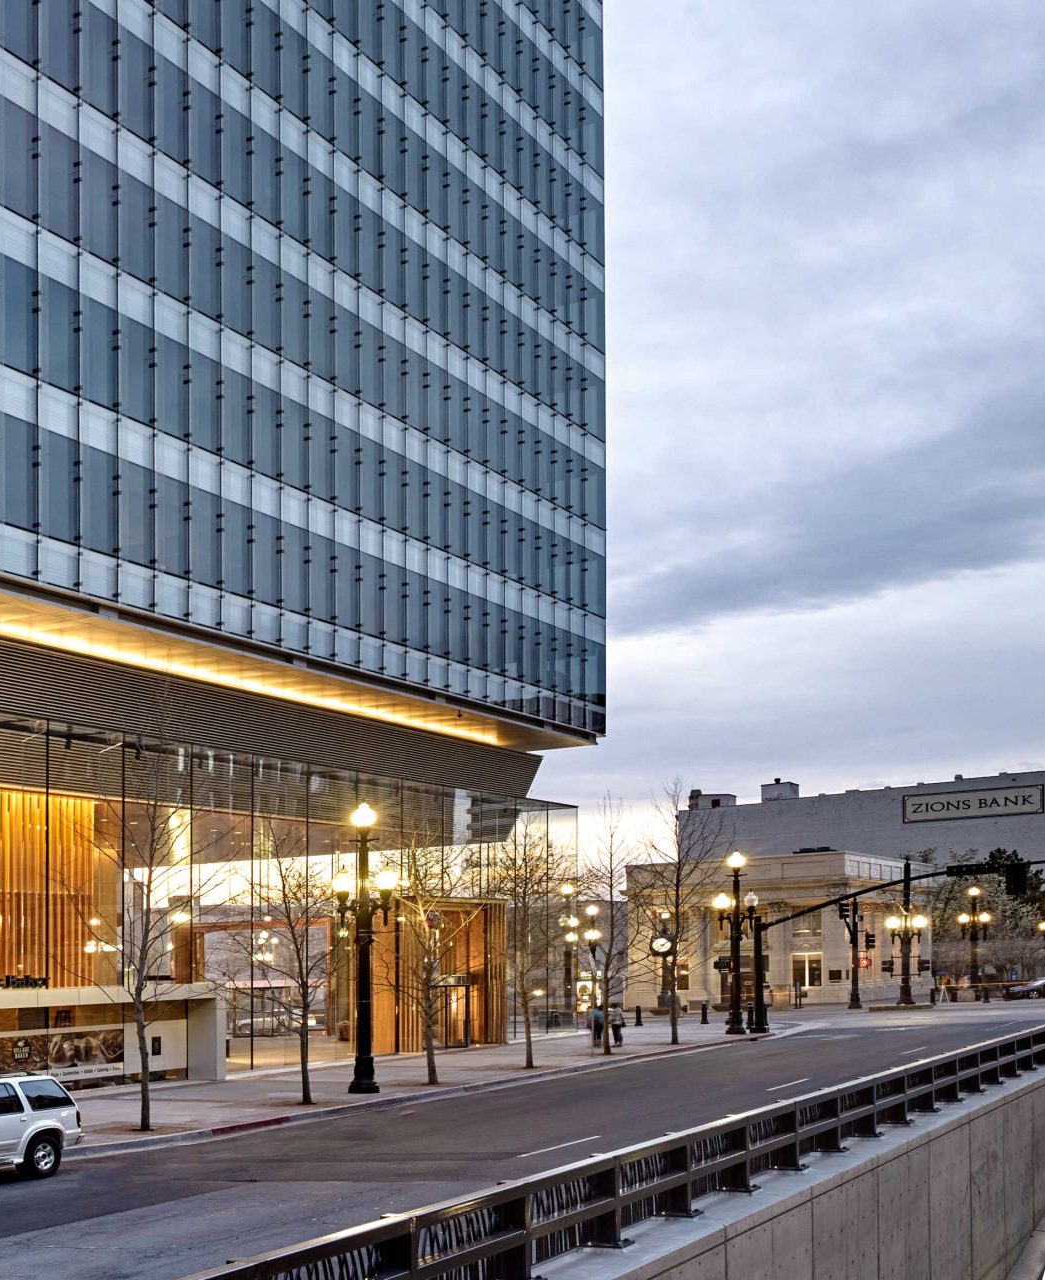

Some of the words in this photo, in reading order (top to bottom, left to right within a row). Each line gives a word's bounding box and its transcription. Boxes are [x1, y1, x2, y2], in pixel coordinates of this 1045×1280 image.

[911, 799, 971, 814] ZIONS
[977, 794, 1035, 809] BANK
[5, 975, 50, 989] Baker
